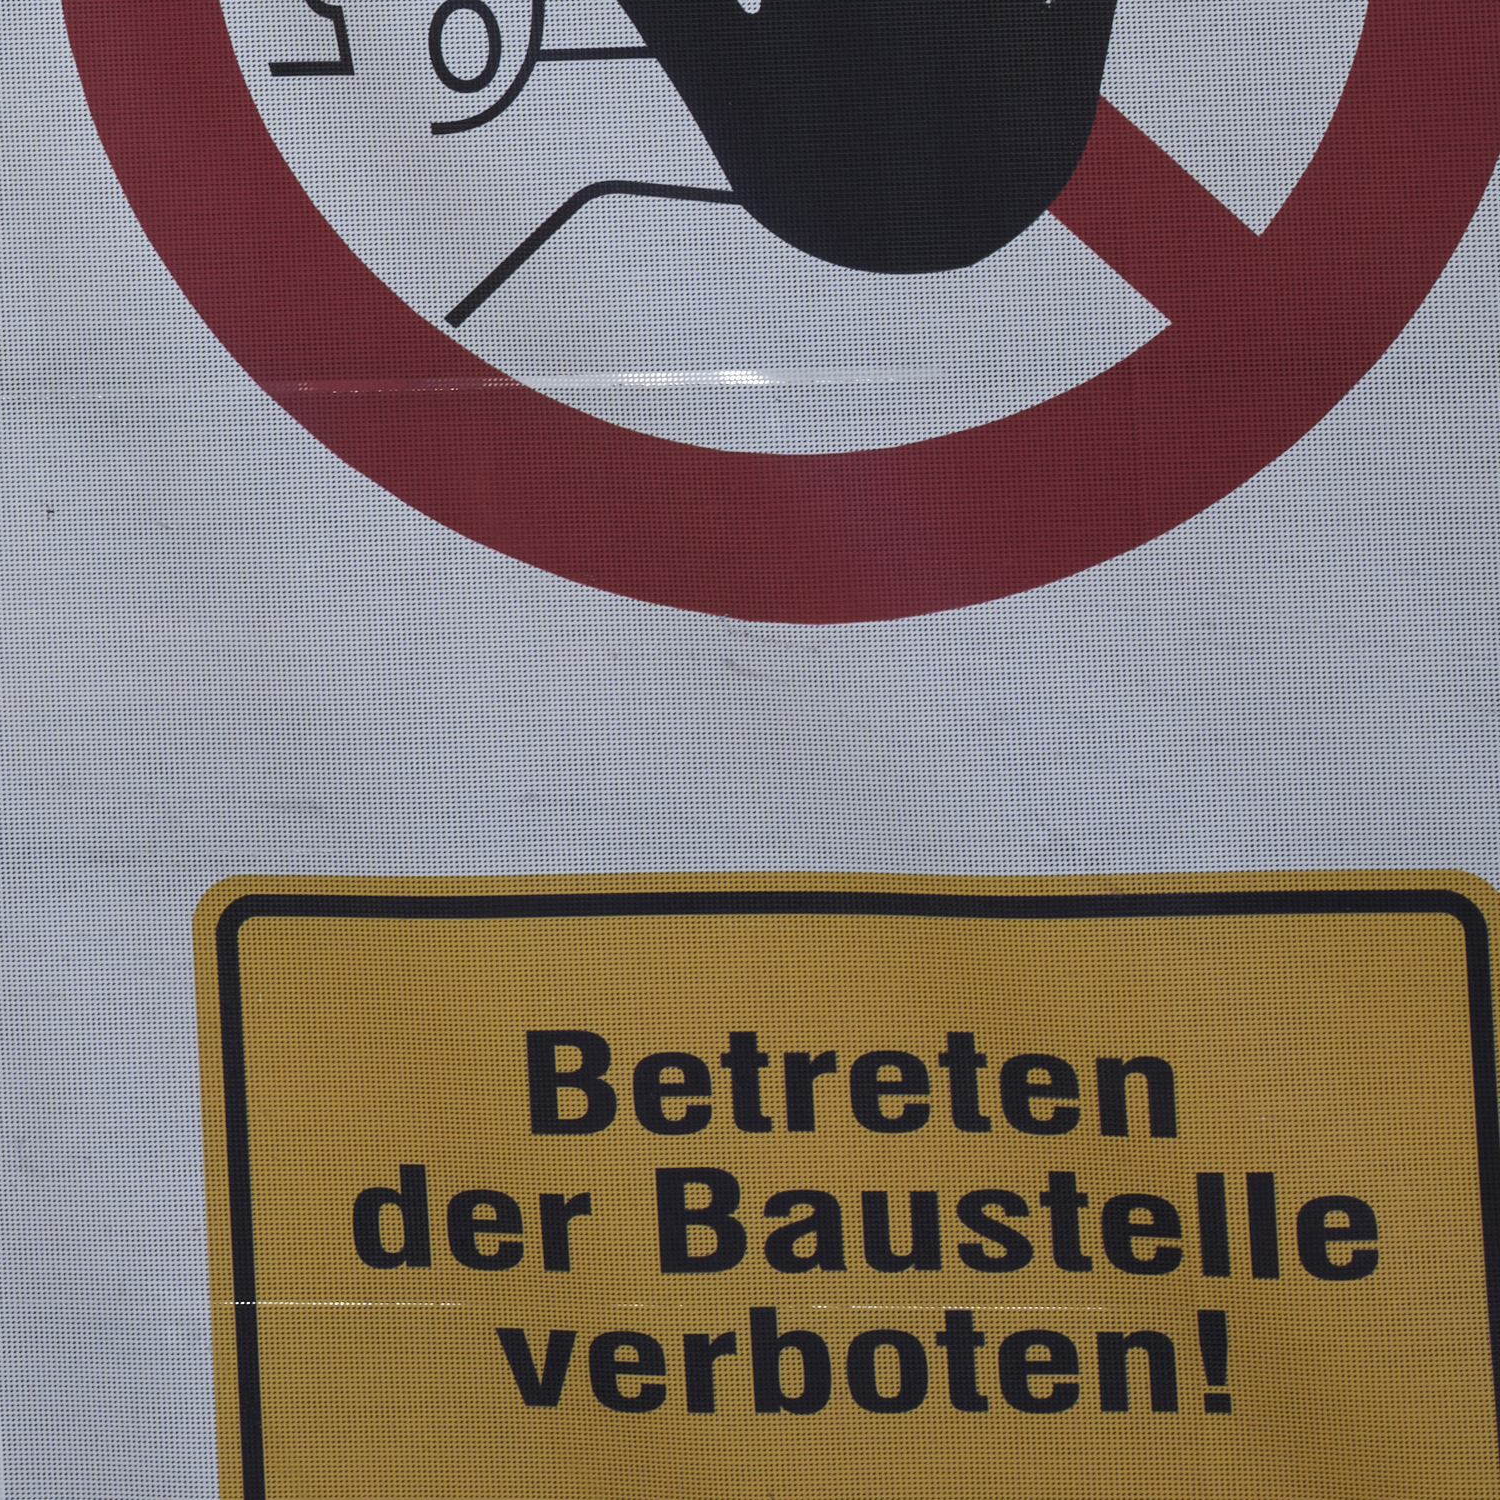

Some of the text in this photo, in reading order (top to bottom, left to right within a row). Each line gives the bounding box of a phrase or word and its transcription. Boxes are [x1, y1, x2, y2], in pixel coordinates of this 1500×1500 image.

[524, 1028, 1179, 1138] Betreten
[351, 1164, 1380, 1280] der Baustelle
[495, 1305, 1232, 1414] verboten!
